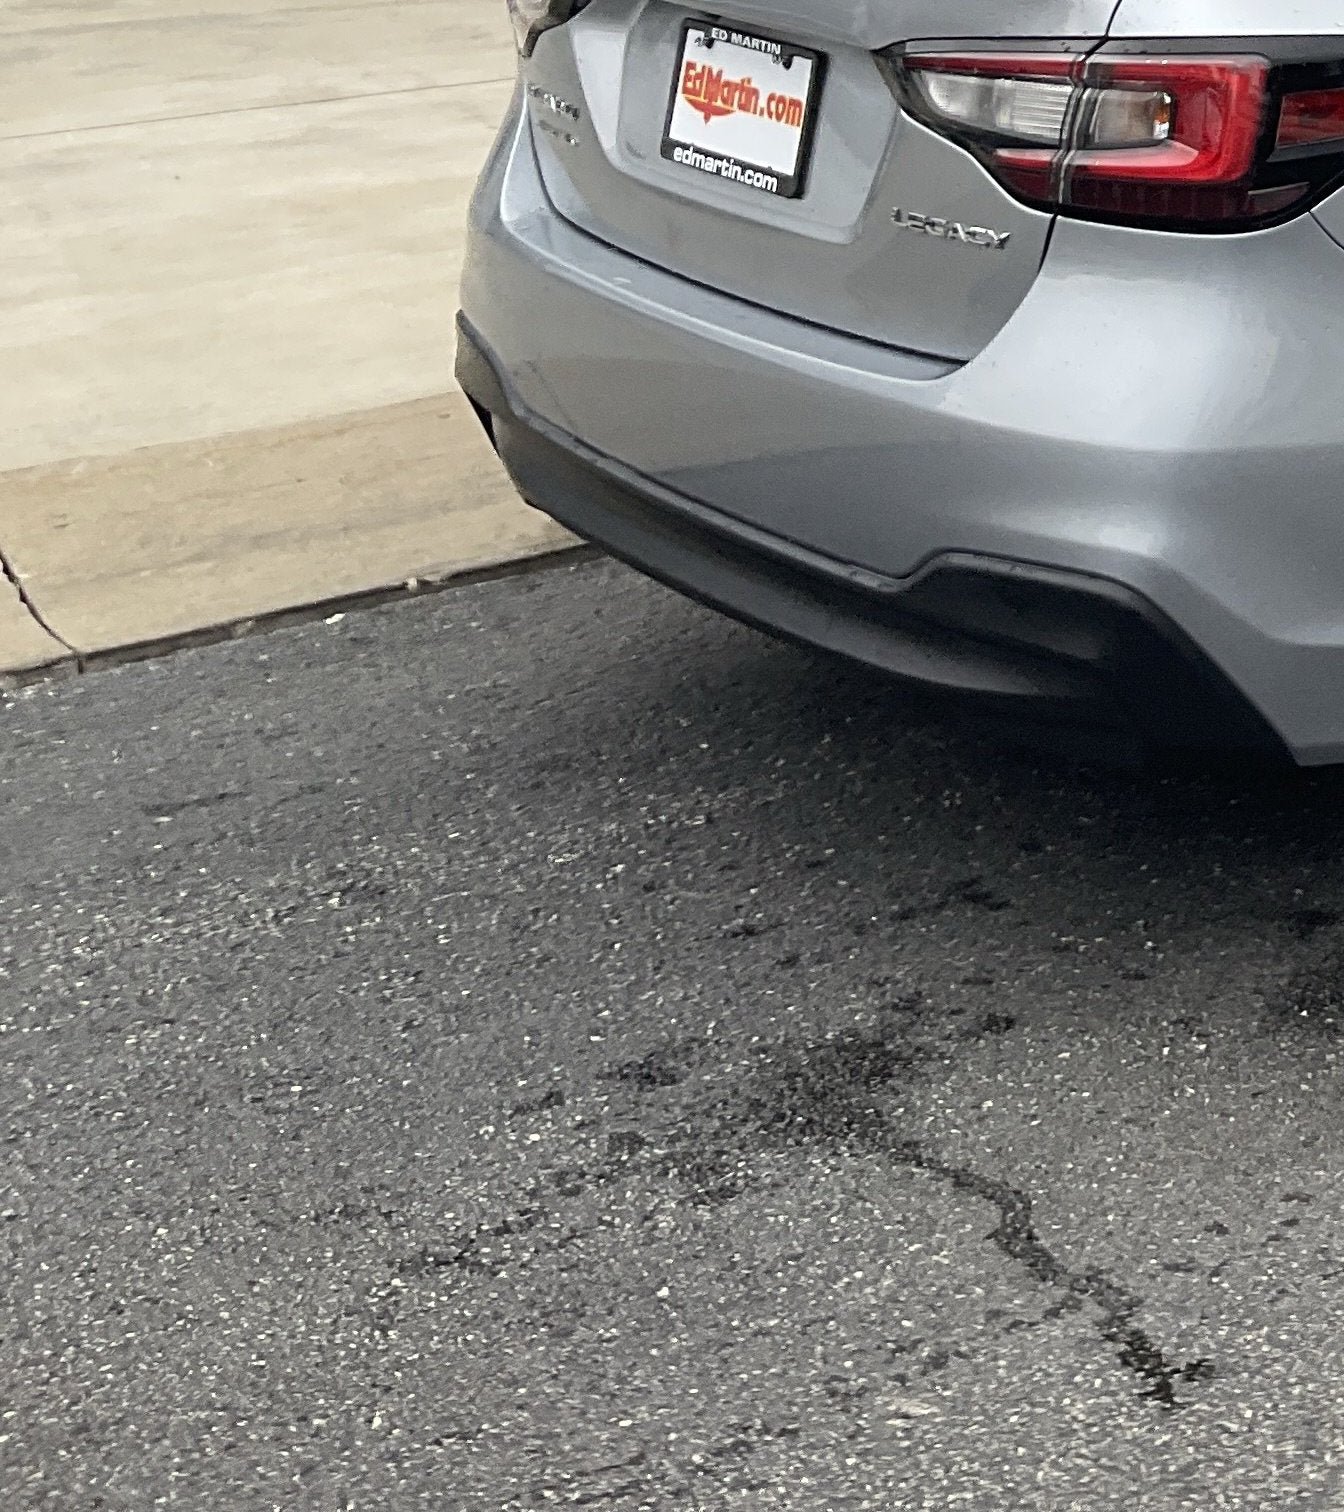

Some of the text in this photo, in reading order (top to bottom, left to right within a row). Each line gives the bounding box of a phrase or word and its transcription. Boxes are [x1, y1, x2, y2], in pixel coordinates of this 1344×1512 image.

[711, 27, 782, 55] ED MARTIN
[673, 146, 778, 193] edmartin.com
[890, 206, 1011, 250] LEGACY
